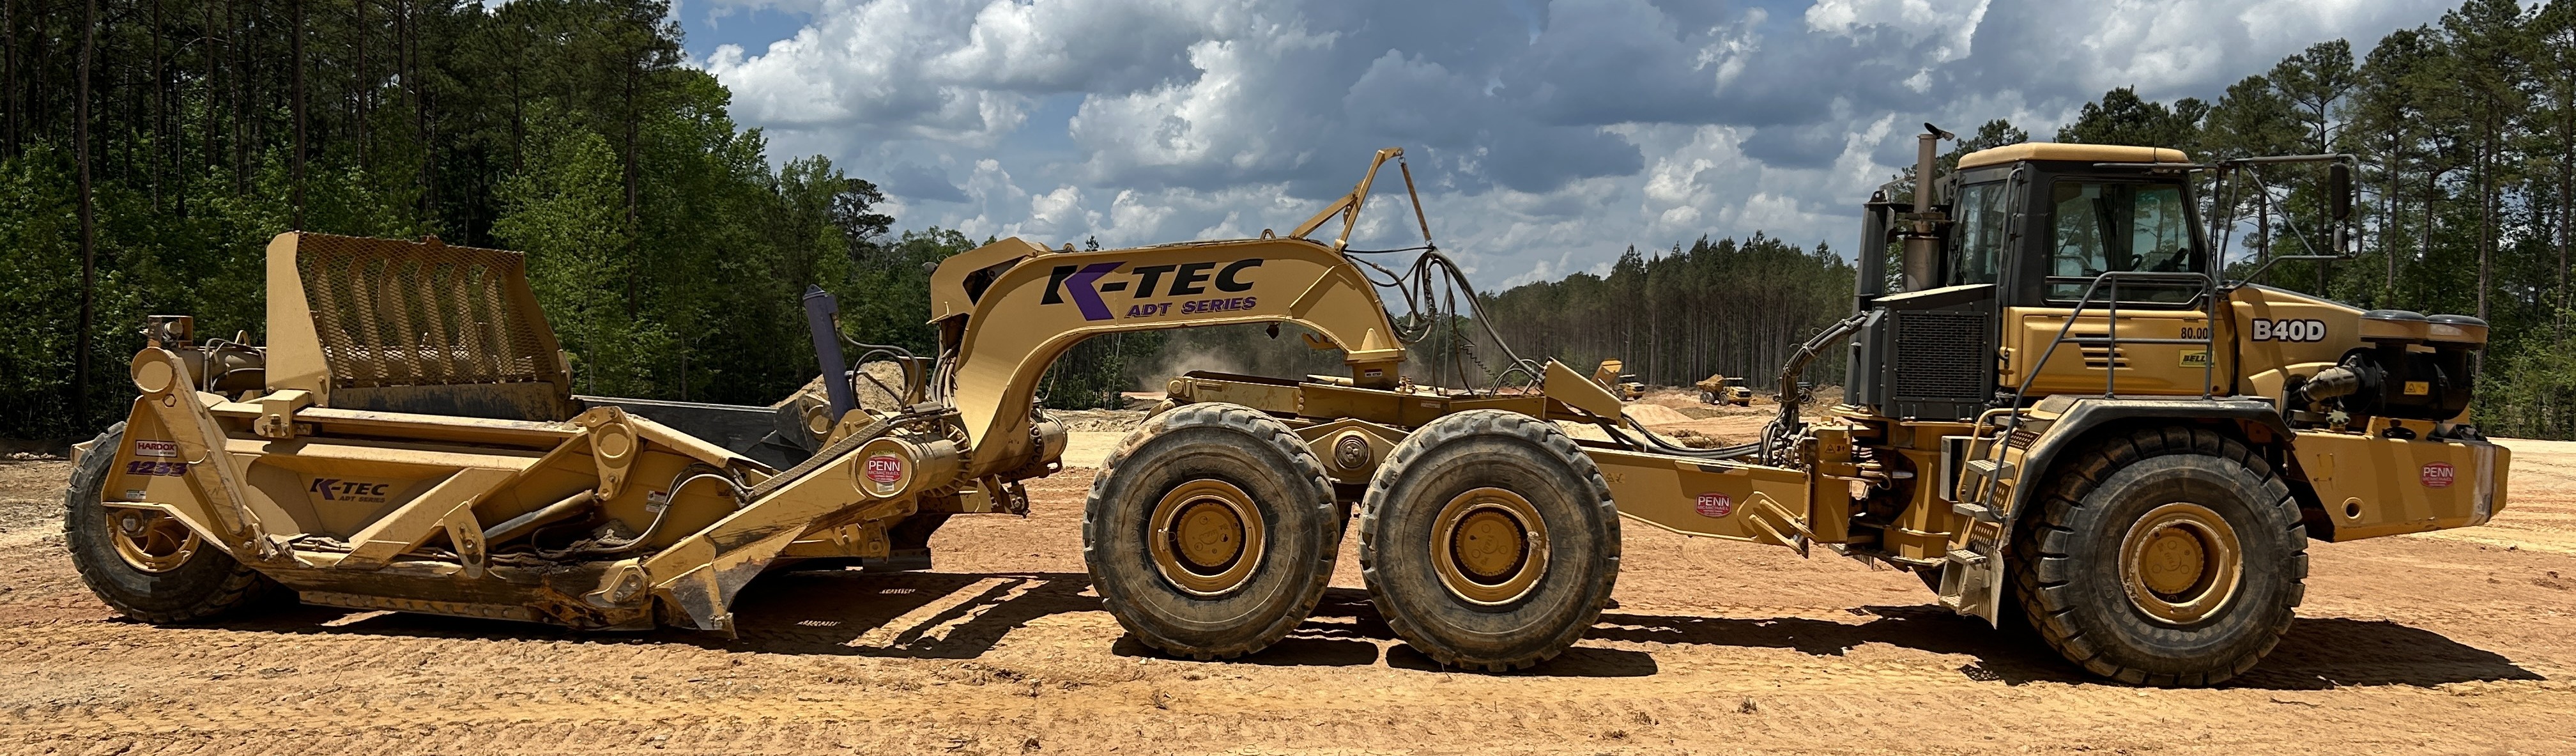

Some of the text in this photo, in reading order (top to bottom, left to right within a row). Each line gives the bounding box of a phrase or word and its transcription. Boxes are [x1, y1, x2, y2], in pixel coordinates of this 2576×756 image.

[1041, 258, 1264, 321] K-TEC
[1124, 297, 1257, 318] ADT SERIES
[2181, 327, 2214, 339] 80.00
[2251, 319, 2327, 342] B40D
[137, 442, 175, 451] HARDOX
[126, 461, 188, 477] 1233
[868, 460, 900, 472] PENN
[2423, 467, 2453, 477] PENN
[309, 478, 389, 500] K-TEC
[1698, 496, 1729, 507] PENN
